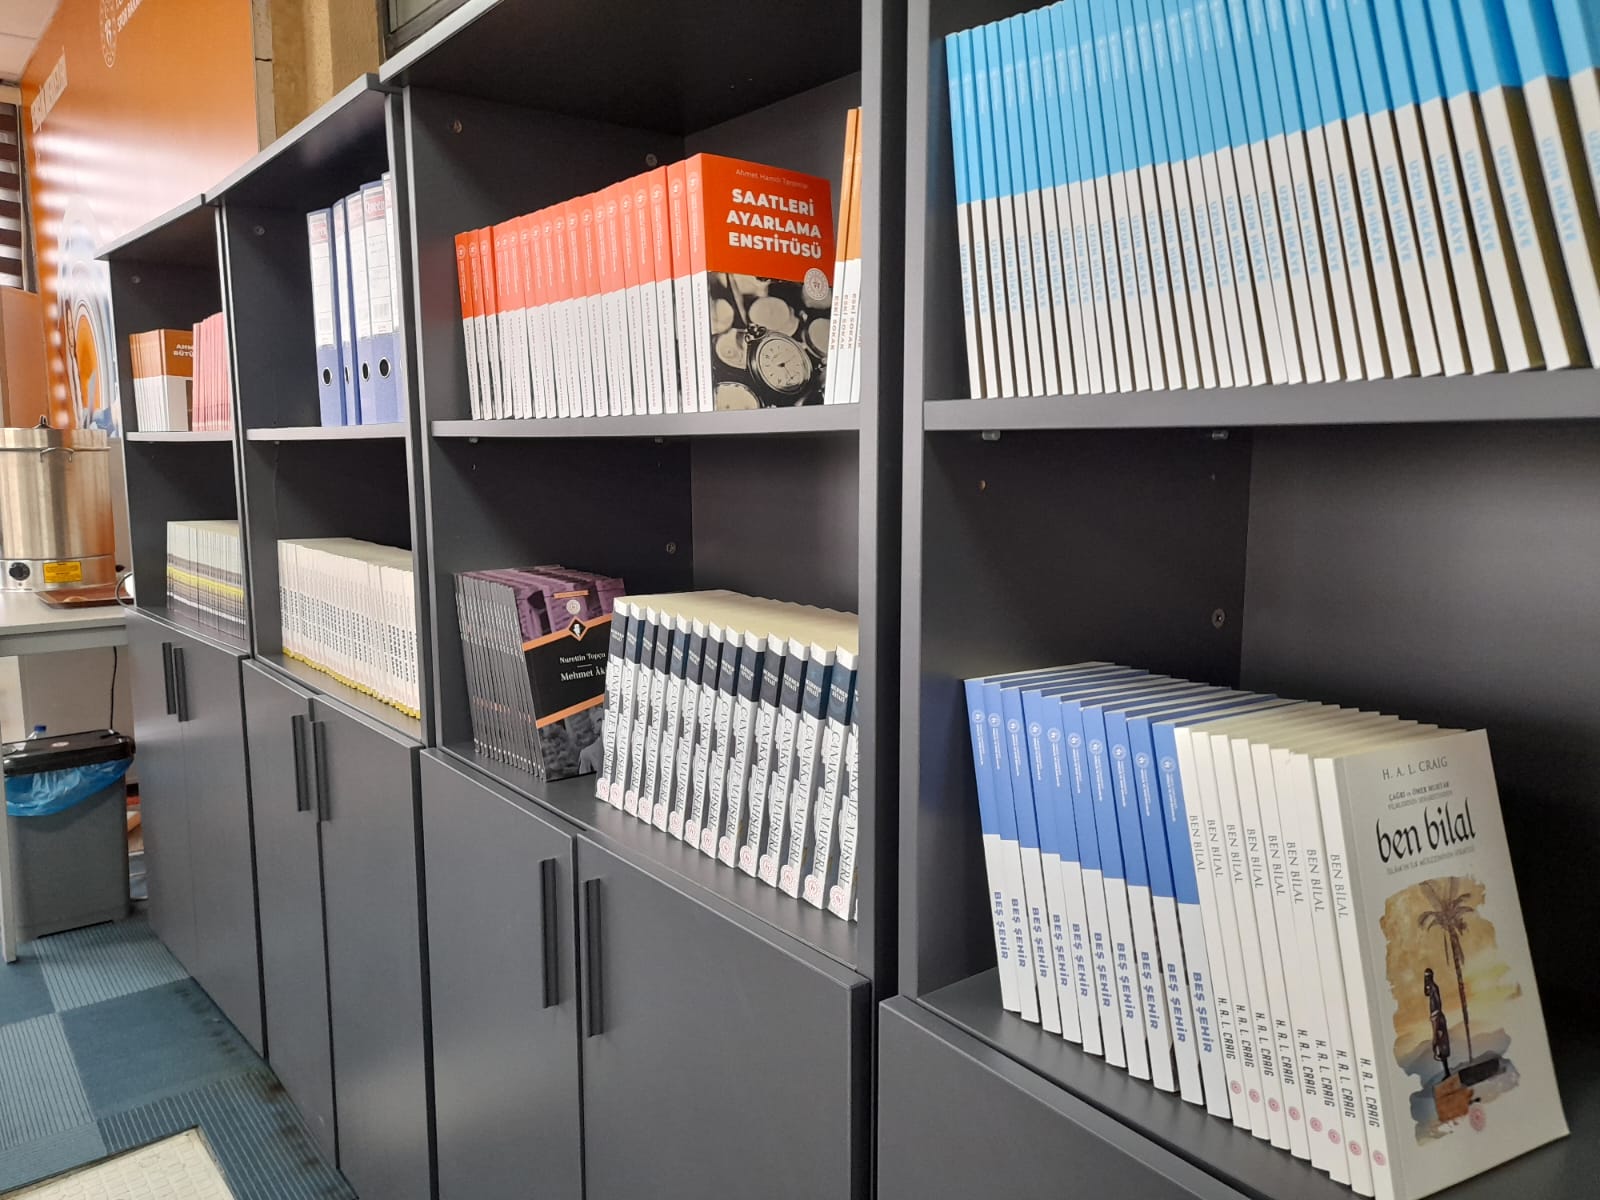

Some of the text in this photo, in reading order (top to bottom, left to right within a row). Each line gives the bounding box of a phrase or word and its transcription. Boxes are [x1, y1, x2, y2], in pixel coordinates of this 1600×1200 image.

[726, 210, 822, 238] AYARLAMA
[732, 188, 814, 217] SAATLERİ
[728, 231, 822, 259] ENSTİTÜSÜ
[560, 670, 594, 682] Mehmet
[1382, 756, 1448, 780] H. A. L. CRAIG
[1189, 815, 1206, 872] BEN BİLAL
[1207, 820, 1224, 878] BEN BİLAL
[1226, 824, 1243, 883] BEN BİLAL
[1246, 828, 1264, 888] BEN BİLAL
[1376, 818, 1422, 863] ben
[1424, 796, 1476, 850] bilal
[1268, 835, 1286, 896] BEN BİLAL
[1286, 842, 1304, 904] BEN BİLAL
[1306, 849, 1325, 912] BEN BİLAL
[1330, 854, 1349, 918] BEN BİLAL
[994, 892, 1010, 959] BEŞ ŞEHİR
[1011, 898, 1027, 967] BEŞ ŞEHİR
[1032, 907, 1049, 978] BEŞ ŞEHİR
[1053, 914, 1069, 986] BEŞ ŞEHİR
[1072, 923, 1090, 997] BEŞ ŞEHİR
[1094, 932, 1112, 1007] BEŞ ŞEHİR
[1117, 942, 1136, 1019] BEŞ ŞEHİR
[1141, 951, 1160, 1029] BEŞ ŞEHİR
[1167, 963, 1187, 1042] BEŞ ŞEHİR
[1193, 972, 1214, 1053] BEŞ ŞEHİR
[1217, 997, 1228, 1006] H.
[1255, 1012, 1266, 1021] H.
[1222, 1032, 1236, 1060] CRAIG
[1235, 1004, 1246, 1013] H.
[1241, 1039, 1255, 1068] CRAIG
[1260, 1048, 1274, 1077] CRAIG
[1275, 1019, 1286, 1028] H.
[1281, 1055, 1295, 1085] CRAIG
[1297, 1029, 1308, 1038] H.
[1315, 1039, 1327, 1048] H.
[1336, 1050, 1348, 1059] H.
[1360, 1058, 1371, 1067] H.
[1302, 1066, 1317, 1095] CRAIG
[1320, 1077, 1335, 1107] CRAIG
[1341, 1088, 1356, 1118] CRAIG
[1365, 1096, 1380, 1128] CRAIG
